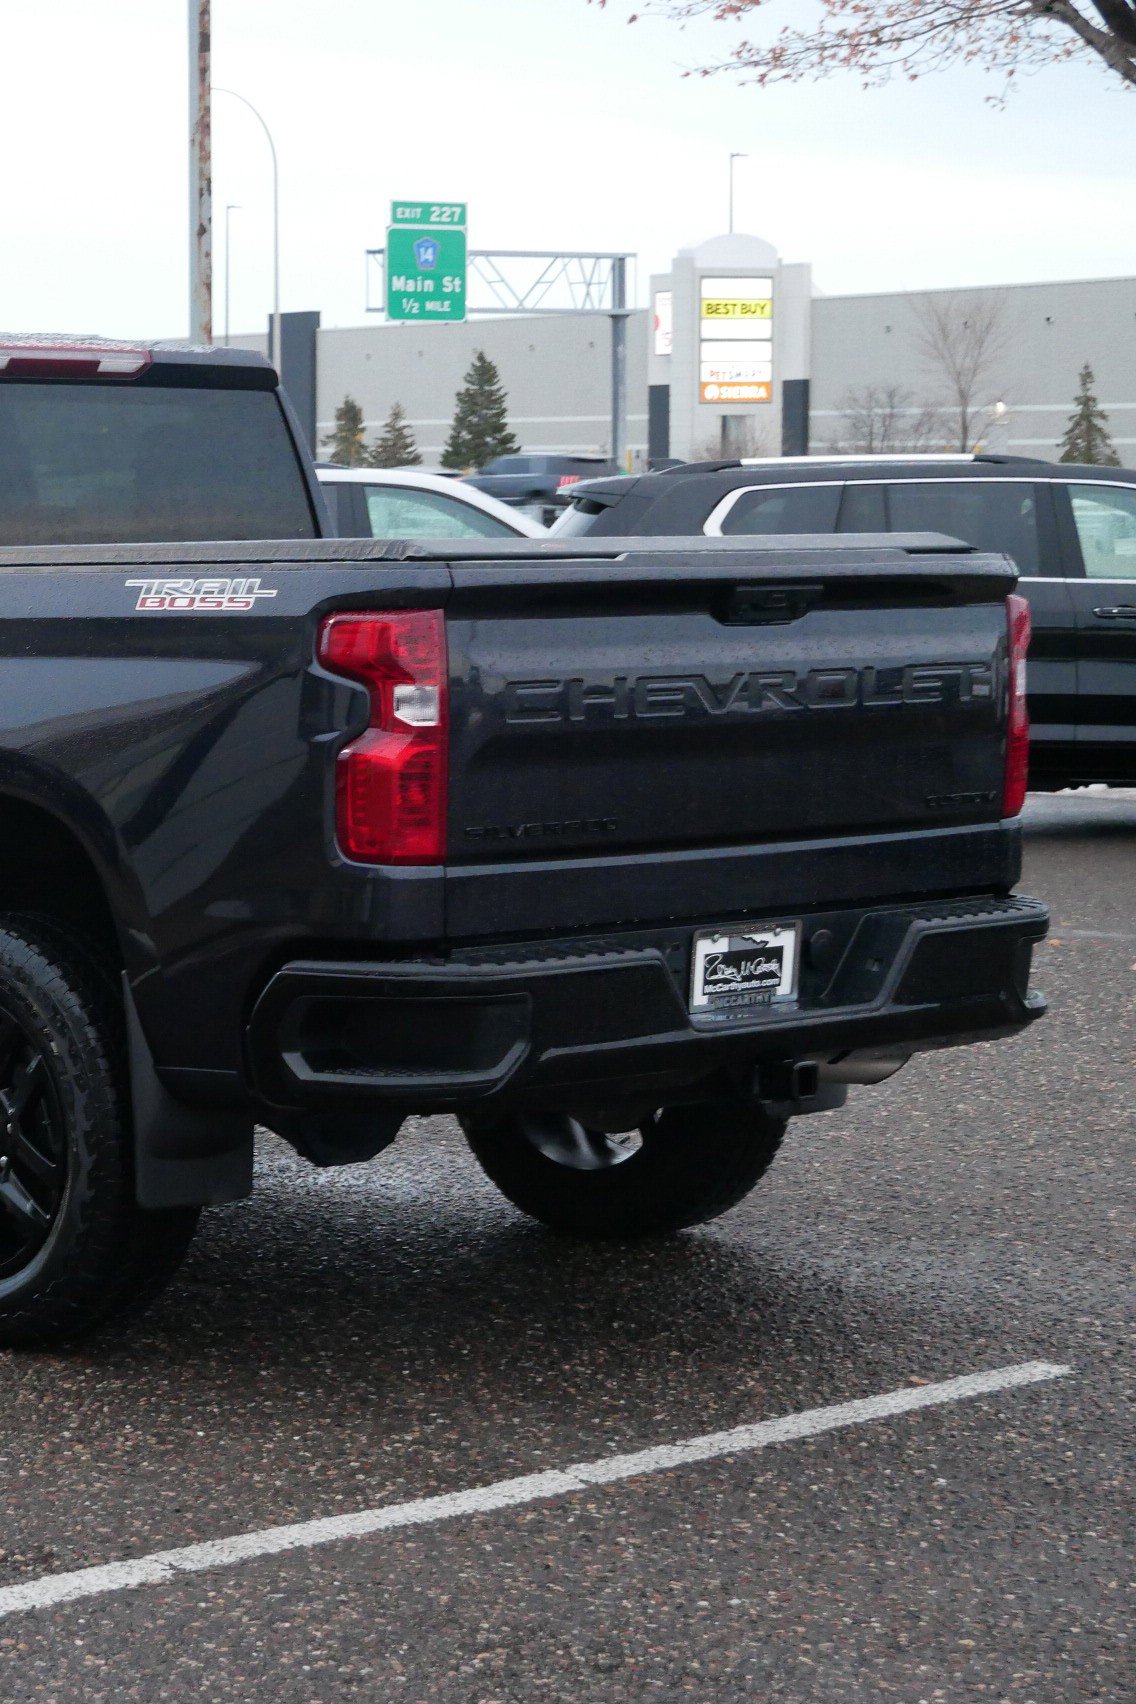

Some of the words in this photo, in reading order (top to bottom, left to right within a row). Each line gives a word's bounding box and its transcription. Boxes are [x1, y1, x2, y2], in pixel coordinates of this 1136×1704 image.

[396, 207, 422, 219] EXIT
[429, 206, 462, 222] 227
[419, 247, 434, 263] 14
[391, 275, 434, 292] Main
[442, 276, 462, 292] St
[425, 300, 451, 312] MILE
[706, 303, 738, 315] BEST
[740, 303, 767, 315] BUY
[125, 578, 278, 597] TRAIL
[135, 595, 256, 611] BOSS
[506, 661, 996, 723] CHEVROLET
